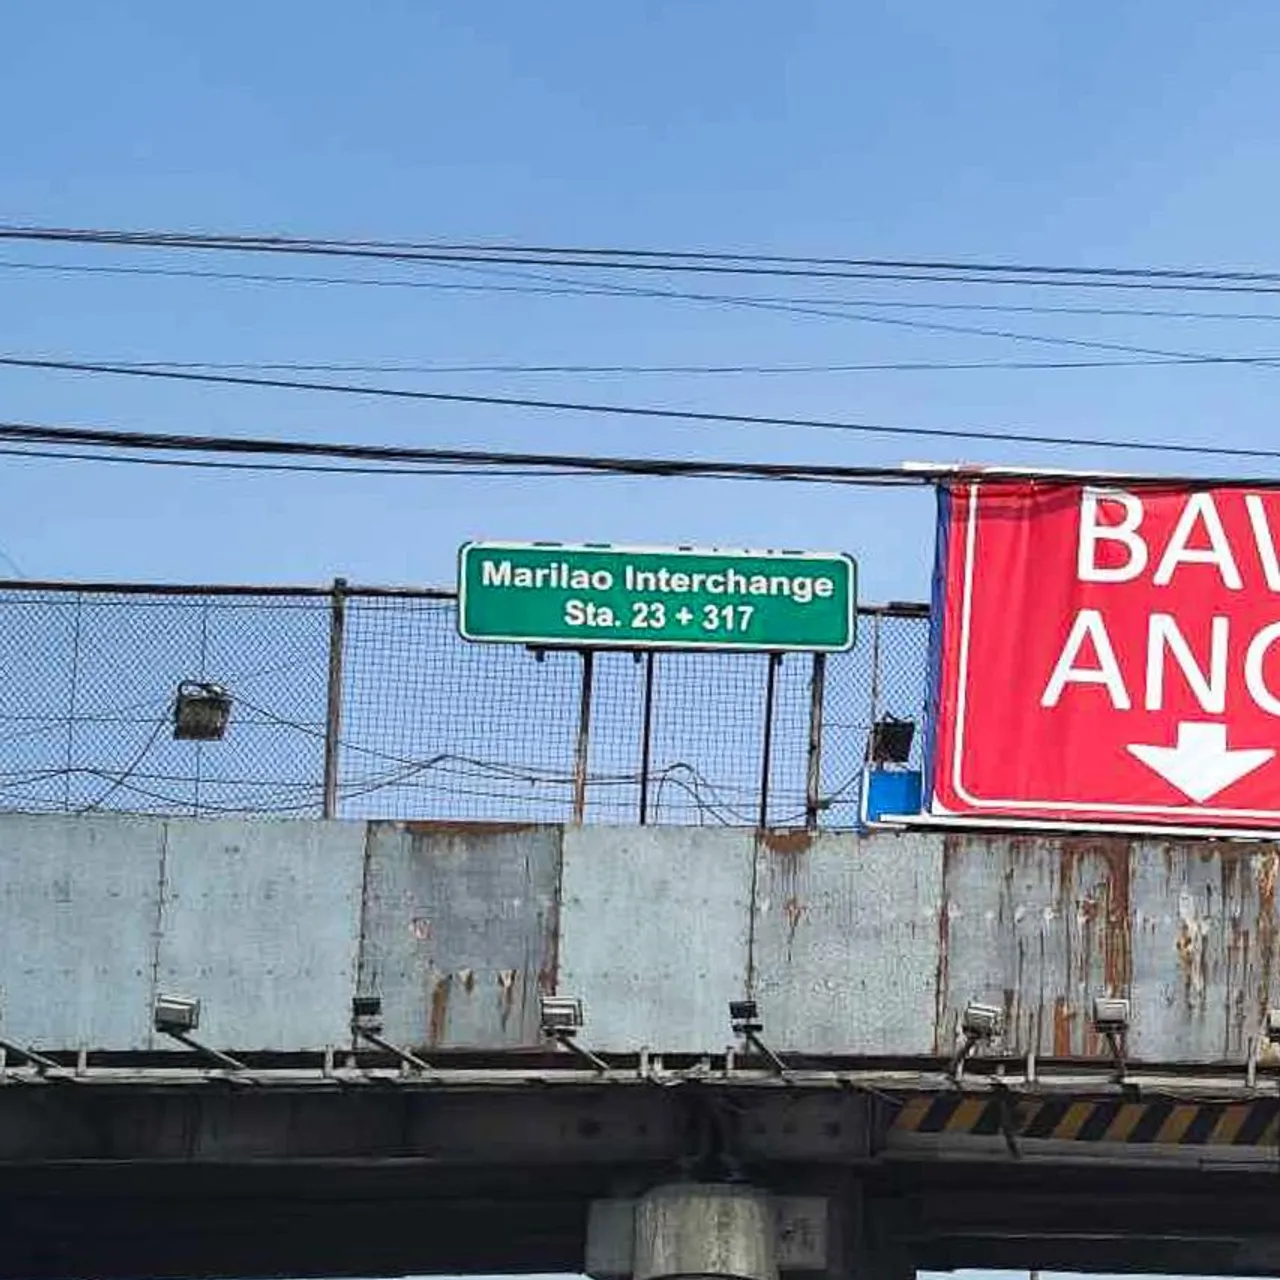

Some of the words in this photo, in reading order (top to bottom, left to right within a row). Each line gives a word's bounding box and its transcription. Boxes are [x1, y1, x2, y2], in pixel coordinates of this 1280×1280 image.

[482, 559, 612, 591] Marilao
[625, 565, 834, 602] Interchange
[564, 600, 621, 627] Sta.
[632, 602, 666, 629] 23
[676, 611, 694, 627] +
[702, 605, 754, 632] 317
